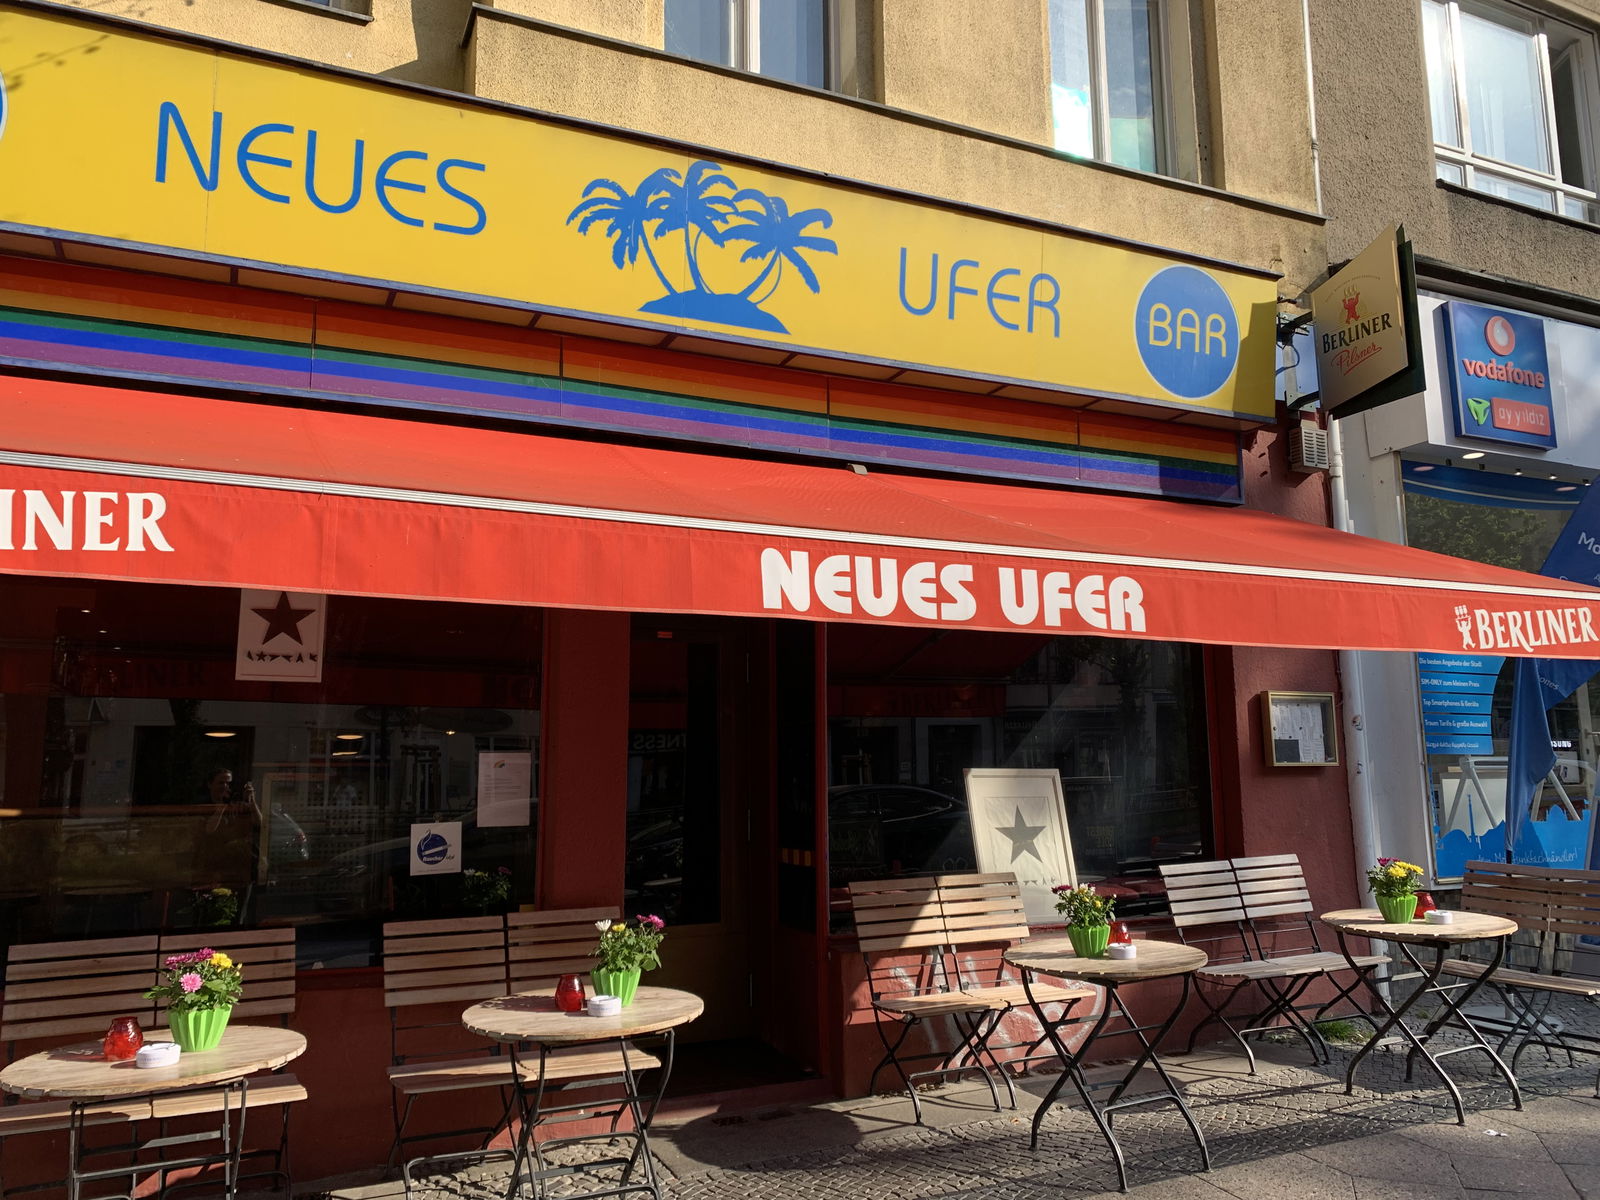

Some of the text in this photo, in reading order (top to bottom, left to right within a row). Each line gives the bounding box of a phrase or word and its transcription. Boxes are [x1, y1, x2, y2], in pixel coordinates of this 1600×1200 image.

[155, 101, 1061, 338] NEUES UFER
[1148, 302, 1227, 358] BAR
[1322, 312, 1393, 354] BERLINER
[1331, 342, 1382, 374] Pilsner
[1462, 358, 1545, 389] vodafone
[1498, 407, 1512, 425] ay
[760, 547, 1147, 633] NEUES UFER
[1473, 606, 1600, 653] BERLINER
